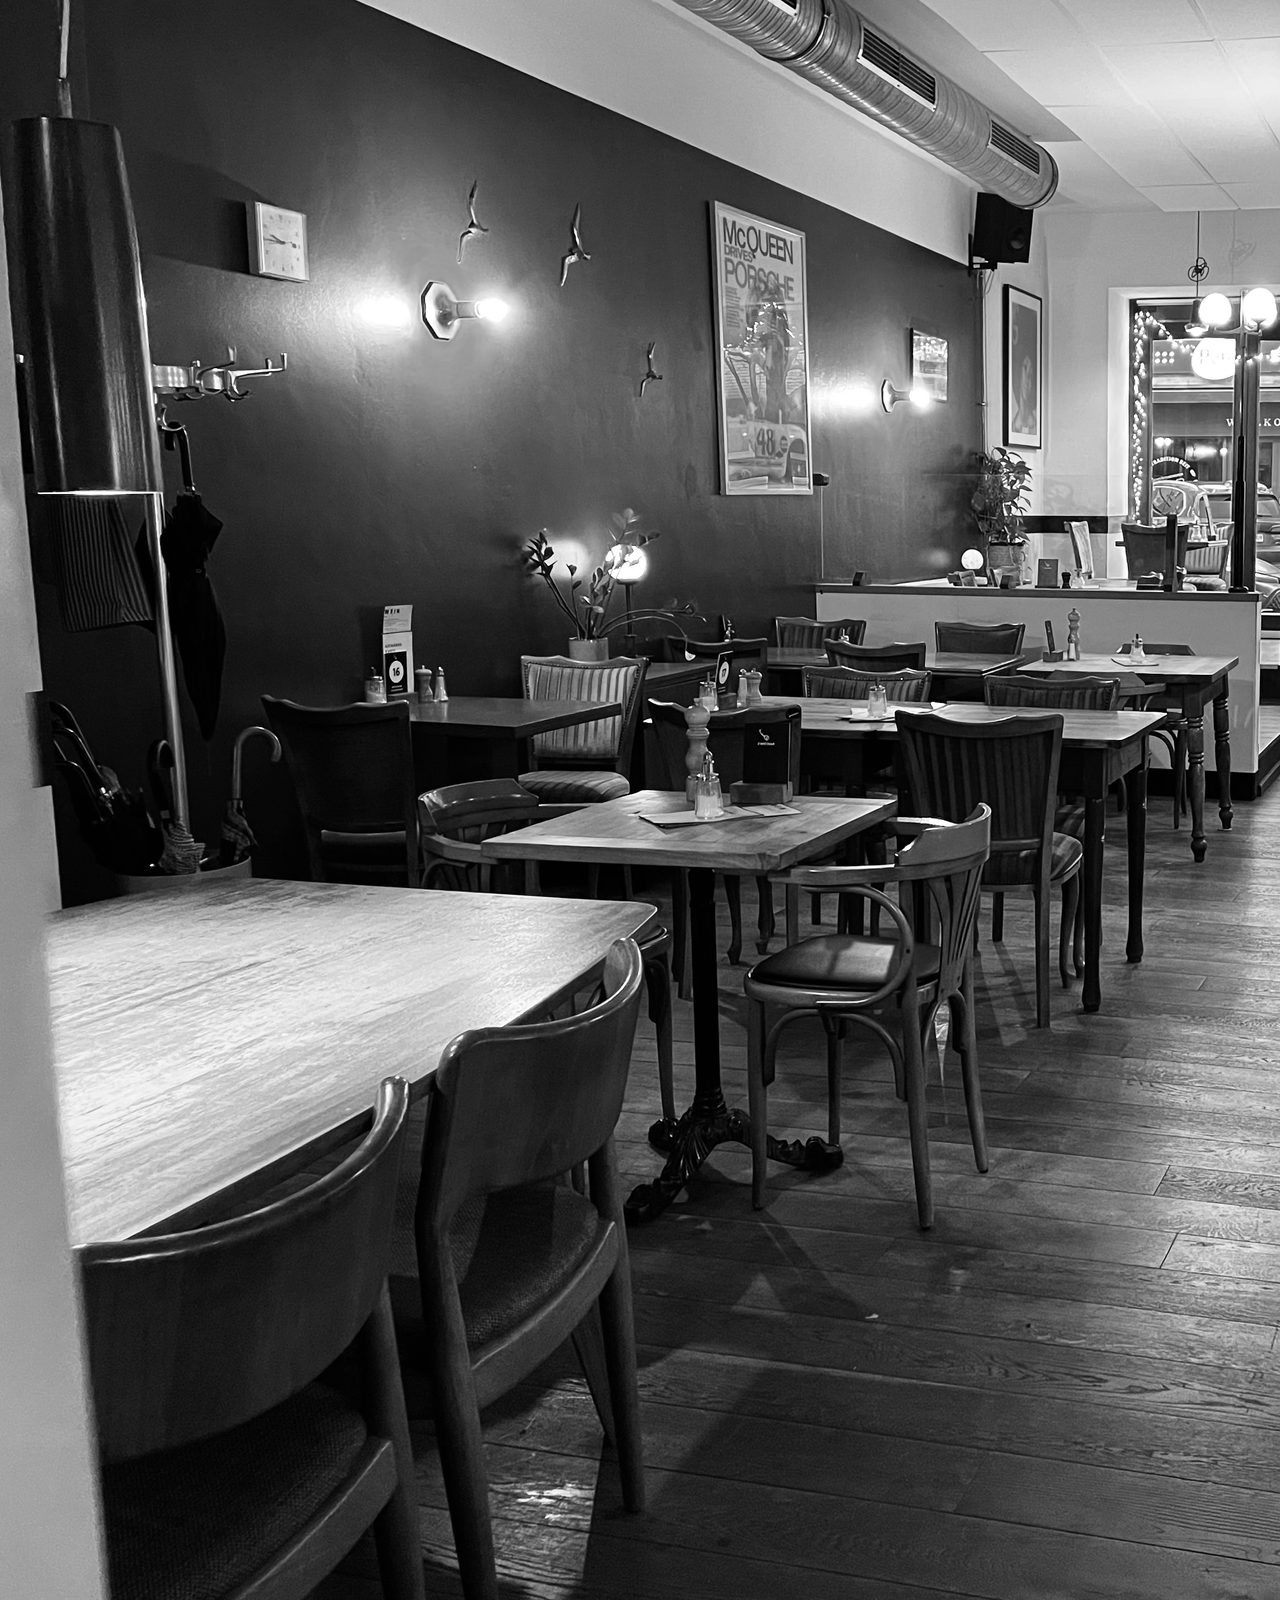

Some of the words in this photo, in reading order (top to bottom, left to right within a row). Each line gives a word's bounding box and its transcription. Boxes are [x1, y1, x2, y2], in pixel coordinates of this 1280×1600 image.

[723, 216, 794, 265] McQUEEN
[724, 243, 753, 263] DRIVES
[724, 257, 795, 302] PORSCHE
[756, 428, 774, 456] 48
[392, 667, 401, 677] 16
